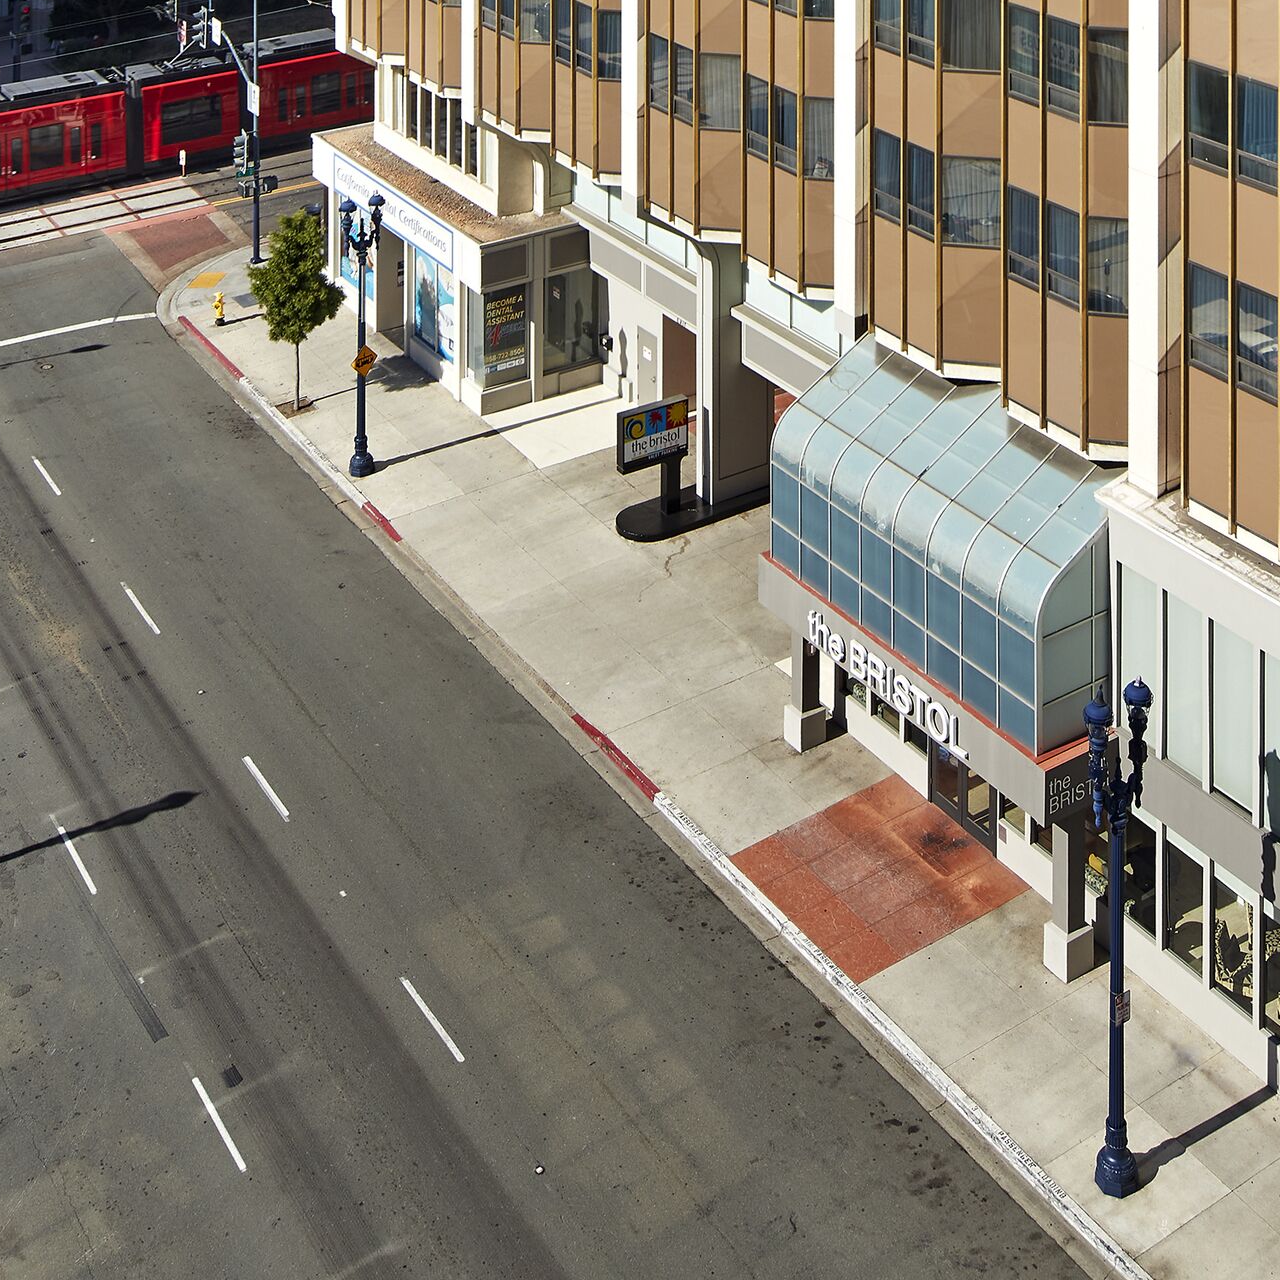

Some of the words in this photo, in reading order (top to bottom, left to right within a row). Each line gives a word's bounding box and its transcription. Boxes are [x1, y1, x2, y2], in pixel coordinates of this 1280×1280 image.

[398, 209, 447, 253] Certifications
[486, 295, 517, 310] BECOME
[517, 294, 523, 303] A
[486, 306, 514, 319] DENTAL
[486, 310, 525, 327] ASSISTANT
[631, 439, 647, 453] the
[649, 427, 680, 448] bristol
[808, 610, 846, 663] the
[849, 639, 970, 761] BRISTOL
[1049, 775, 1071, 796] the
[998, 1130, 1037, 1169] PASSENGER
